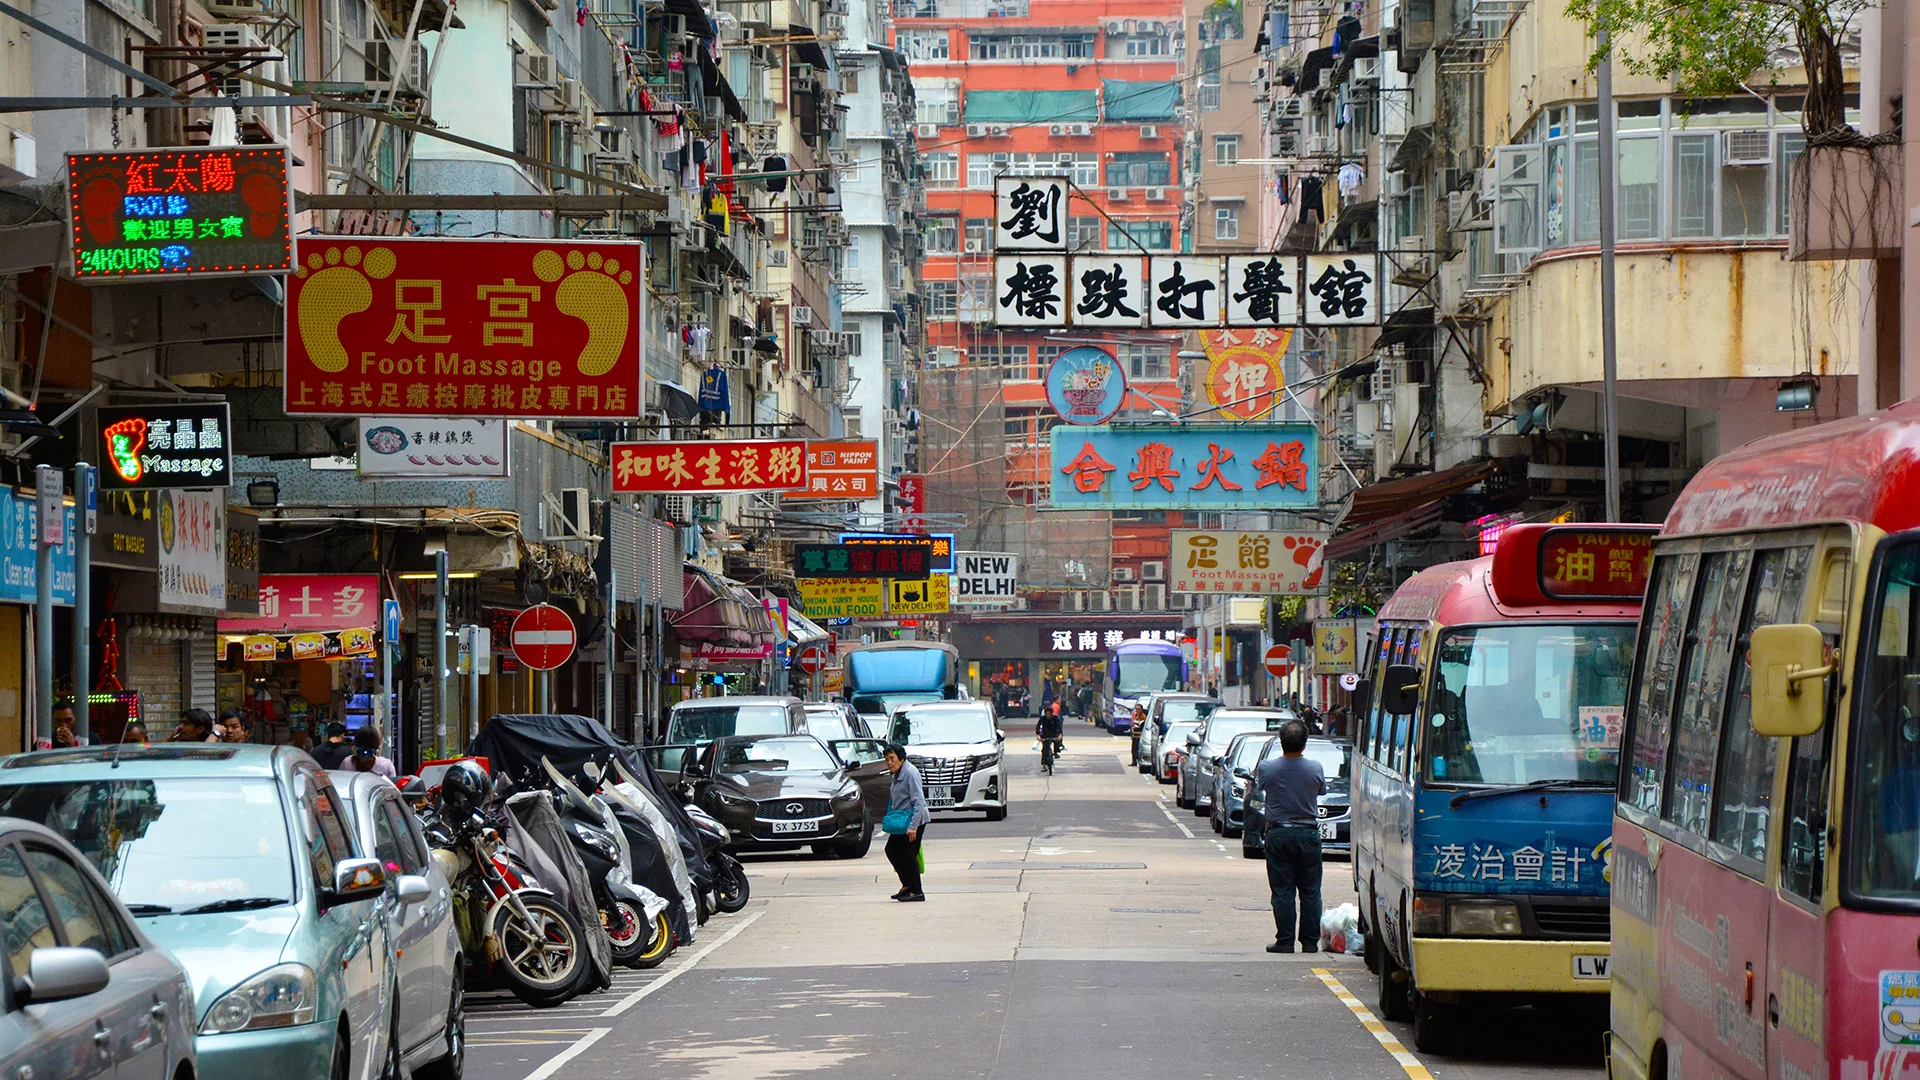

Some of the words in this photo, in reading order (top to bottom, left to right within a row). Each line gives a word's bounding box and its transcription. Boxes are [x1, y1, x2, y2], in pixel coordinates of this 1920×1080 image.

[126, 156, 236, 195] 紅太陽
[124, 195, 165, 216] FOOT
[1000, 182, 1062, 244] 劉
[122, 215, 244, 242] 歡迎男女賓
[80, 247, 160, 272] 24HOURS
[361, 352, 426, 374] Foot
[434, 353, 561, 381] Massage
[292, 381, 627, 411] 上海式足療按摩批皮專門店
[1222, 360, 1269, 412] 押
[147, 418, 222, 450] 亮晶晶
[141, 454, 224, 476] Massage
[617, 446, 802, 487] 和味生滾粥
[1060, 440, 1309, 493] 合興火鍋
[87, 467, 96, 506] P
[1187, 534, 1270, 569] 足館
[1555, 548, 1595, 582] 油
[966, 557, 1010, 574] NEW
[1192, 570, 1221, 579] Foot
[1226, 570, 1284, 580] Massage
[804, 597, 827, 605] JORDAN
[832, 595, 852, 603] CURRY
[857, 595, 879, 603] HOUSE
[960, 578, 1015, 595] DELHI
[1177, 581, 1299, 592] 足療按摩專門店
[805, 605, 841, 616] INDIAN
[846, 604, 877, 615] FOOD
[911, 602, 932, 610] DELHI
[1583, 716, 1606, 743] 油
[791, 822, 816, 831] 3752
[1433, 843, 1586, 882] 凌治會計
[1578, 958, 1608, 975] LW
